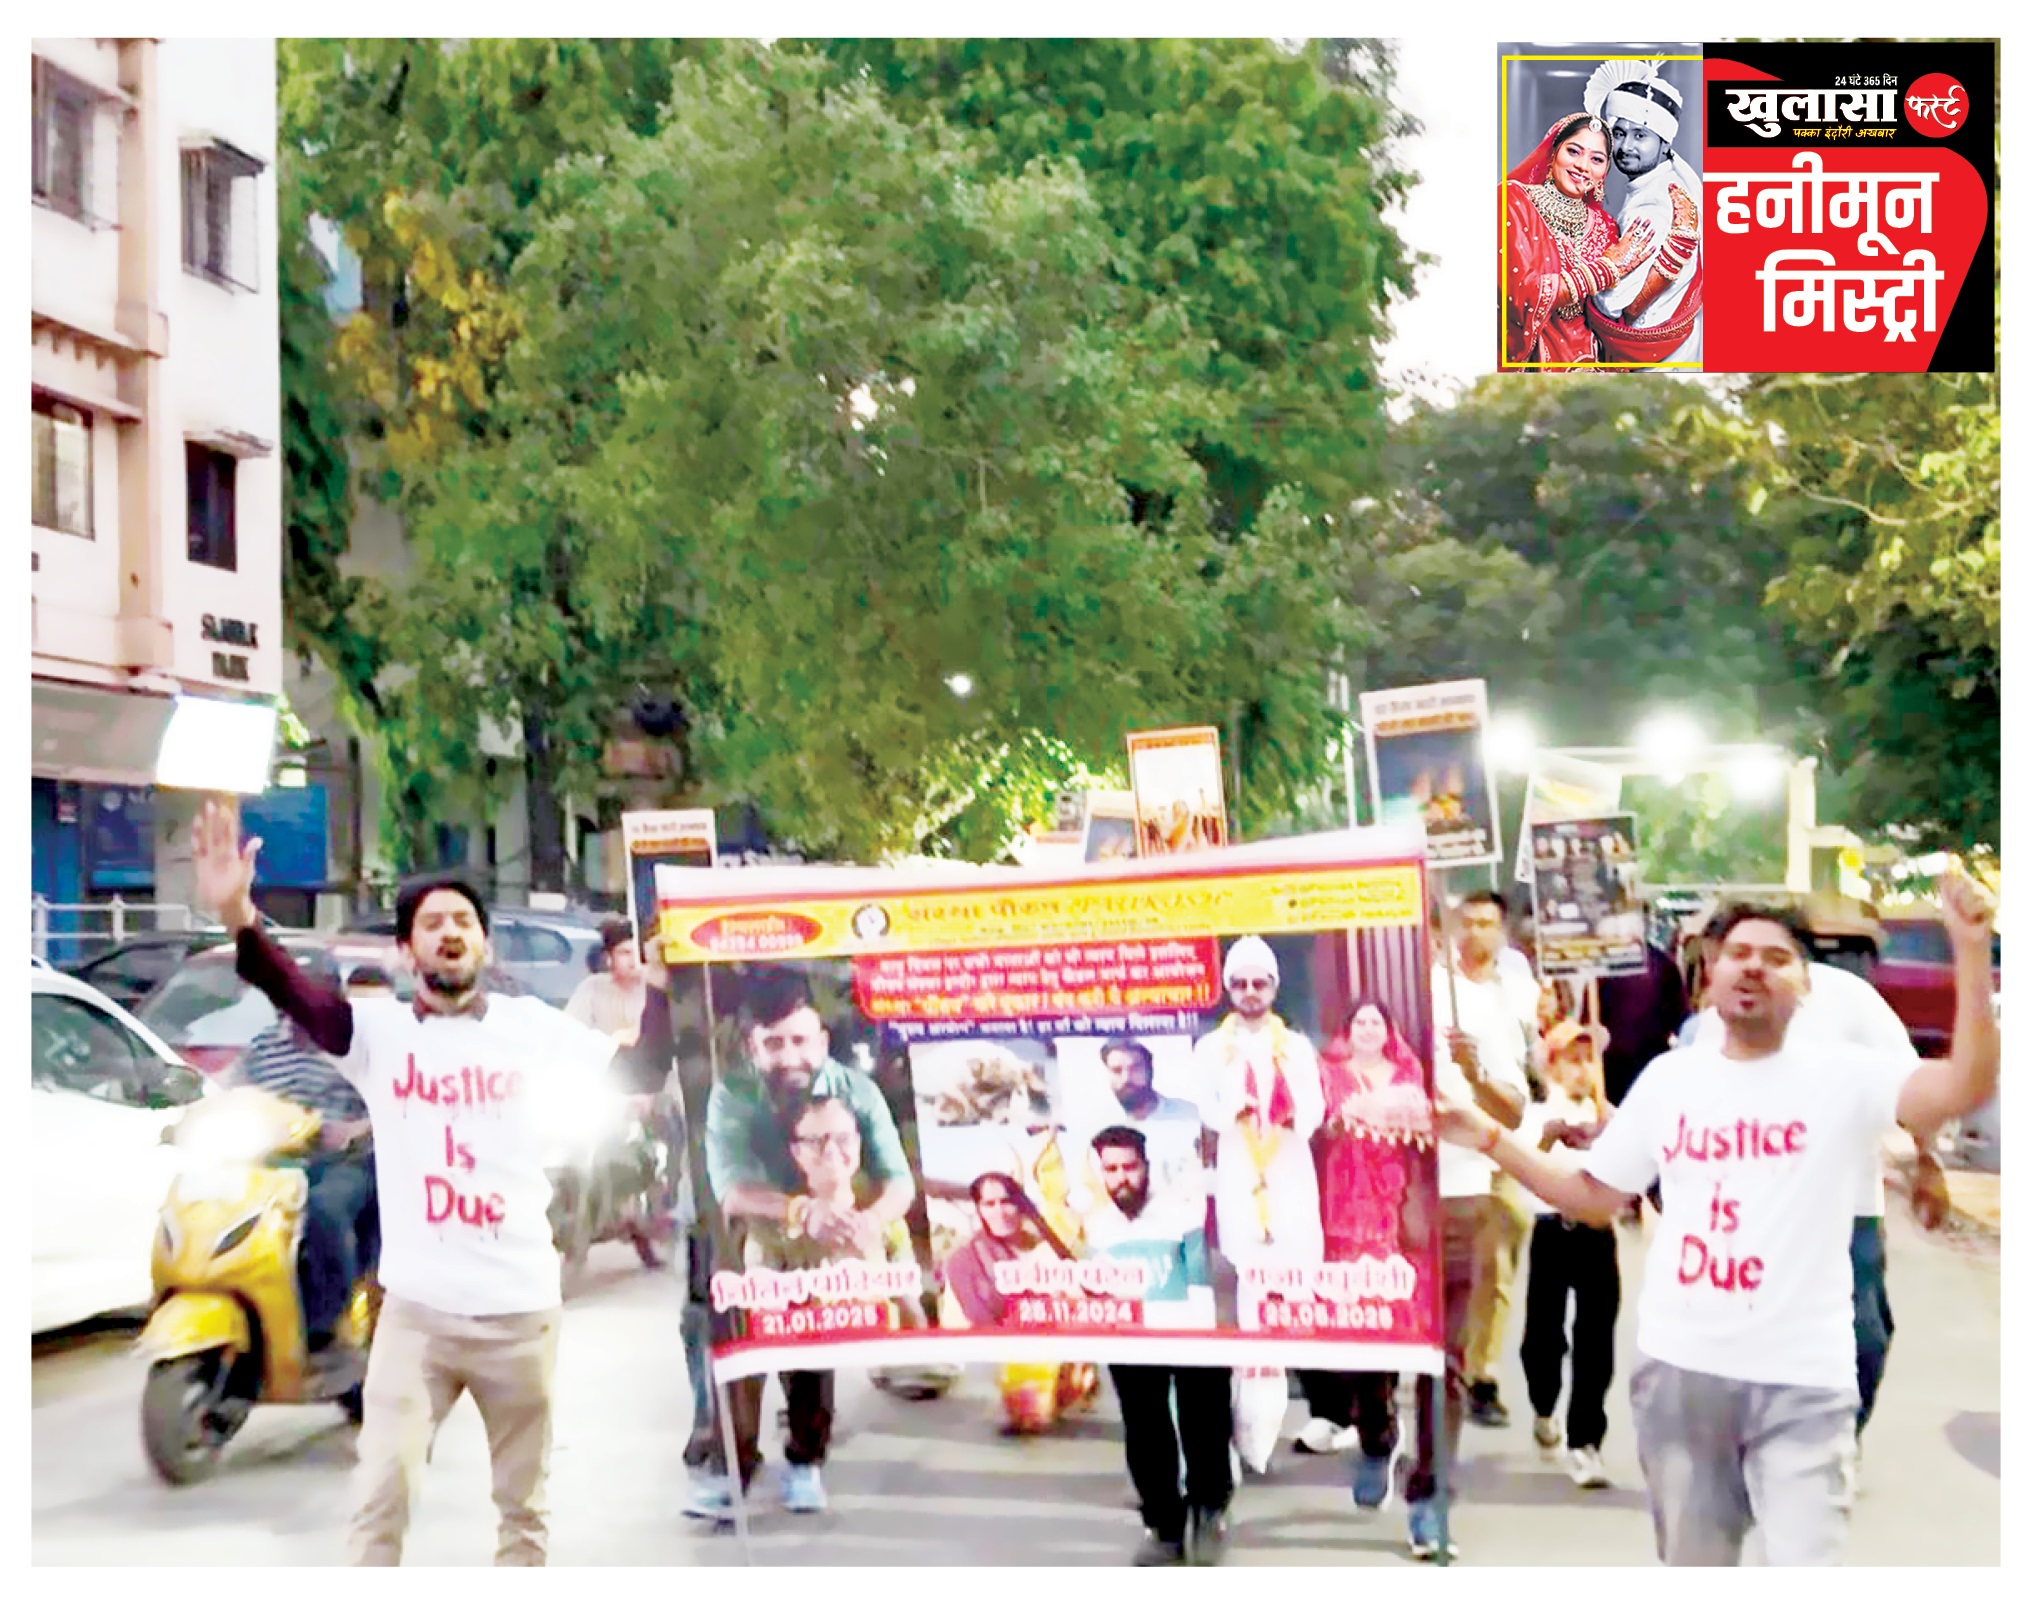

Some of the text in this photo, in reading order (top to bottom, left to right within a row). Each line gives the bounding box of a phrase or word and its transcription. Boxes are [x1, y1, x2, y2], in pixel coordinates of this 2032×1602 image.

[1662, 1111, 1807, 1163] Justice
[424, 1174, 505, 1228] Due
[1677, 1233, 1764, 1292] Due
